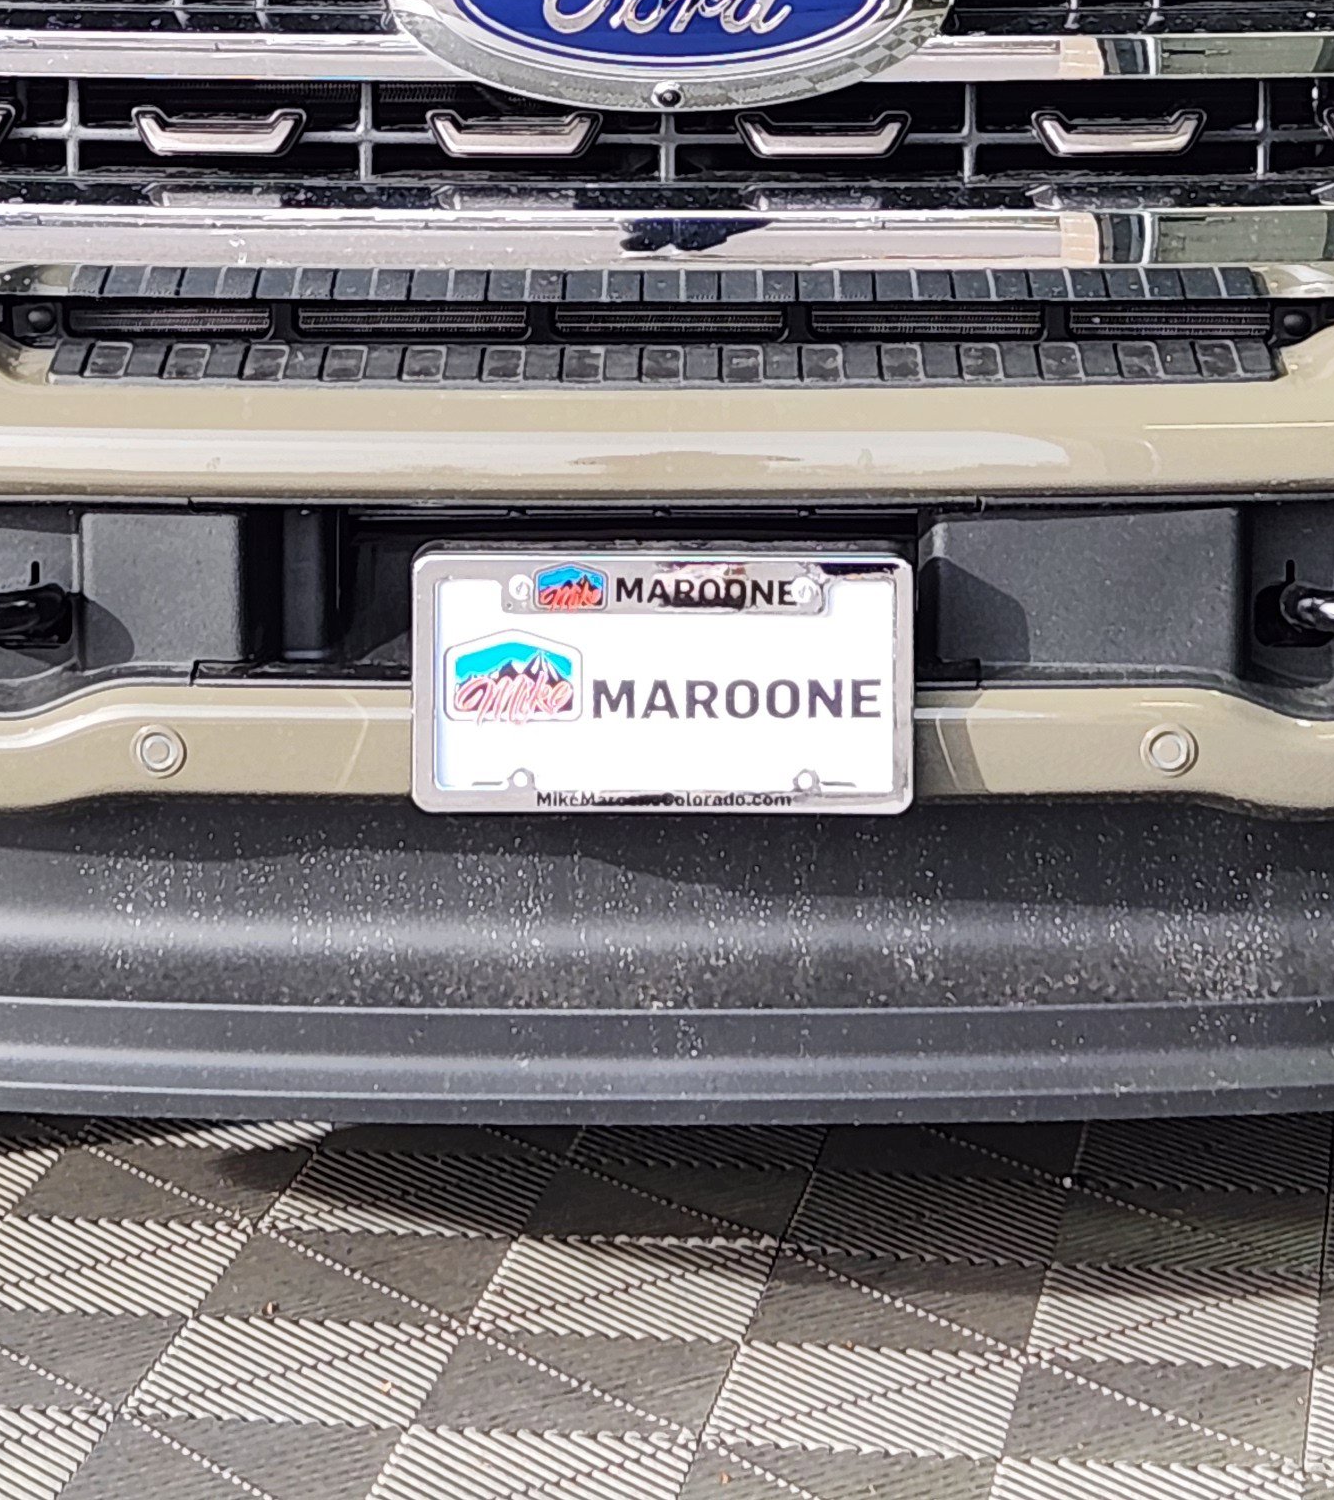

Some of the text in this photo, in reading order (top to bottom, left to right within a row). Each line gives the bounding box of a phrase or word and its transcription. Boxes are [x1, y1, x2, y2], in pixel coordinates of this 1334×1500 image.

[615, 576, 797, 607] MAROONE
[455, 672, 882, 726] Mike MAROONE
[536, 791, 793, 808] MikeMaroColorado.com
